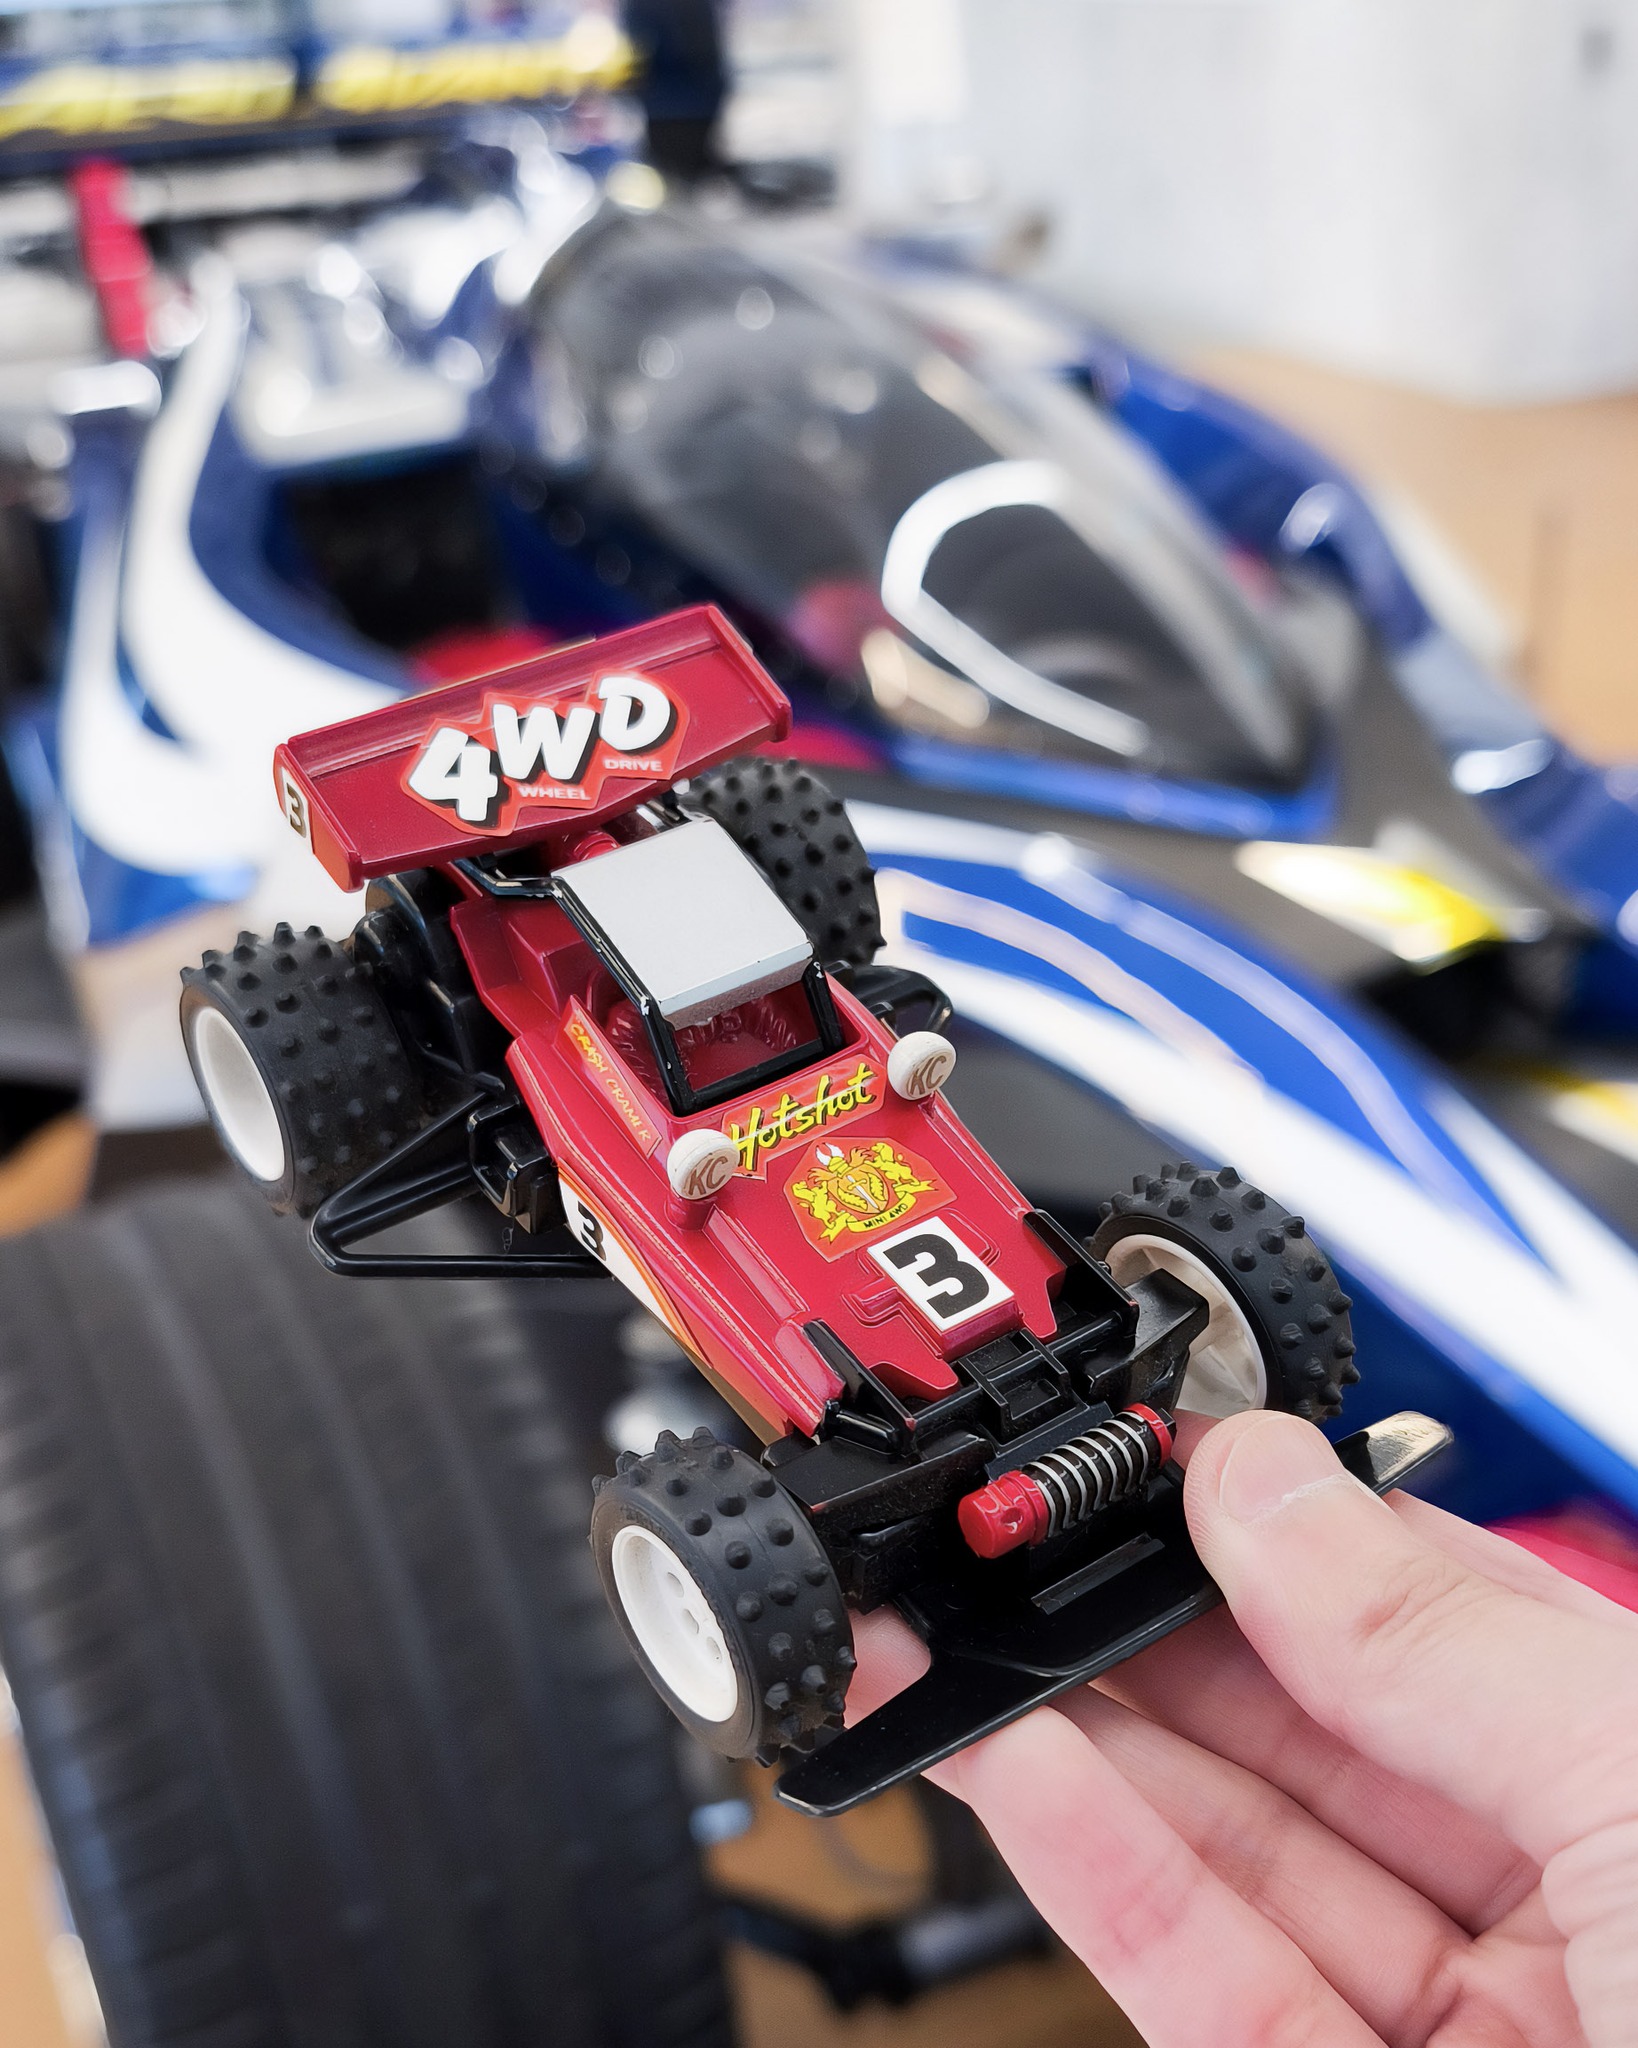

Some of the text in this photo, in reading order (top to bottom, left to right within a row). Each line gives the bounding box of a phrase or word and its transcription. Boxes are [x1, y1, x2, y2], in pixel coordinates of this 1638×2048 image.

[409, 675, 674, 823] 4WD
[603, 758, 663, 772] DRIVE
[286, 782, 307, 839] 3
[516, 784, 592, 801] WHEEL
[908, 1053, 945, 1092] KC
[730, 1062, 878, 1172] Hotshot
[688, 1155, 729, 1196] KC
[577, 1200, 607, 1262] 3
[863, 1203, 909, 1229] MINI 4WD
[884, 1233, 990, 1319] 3
